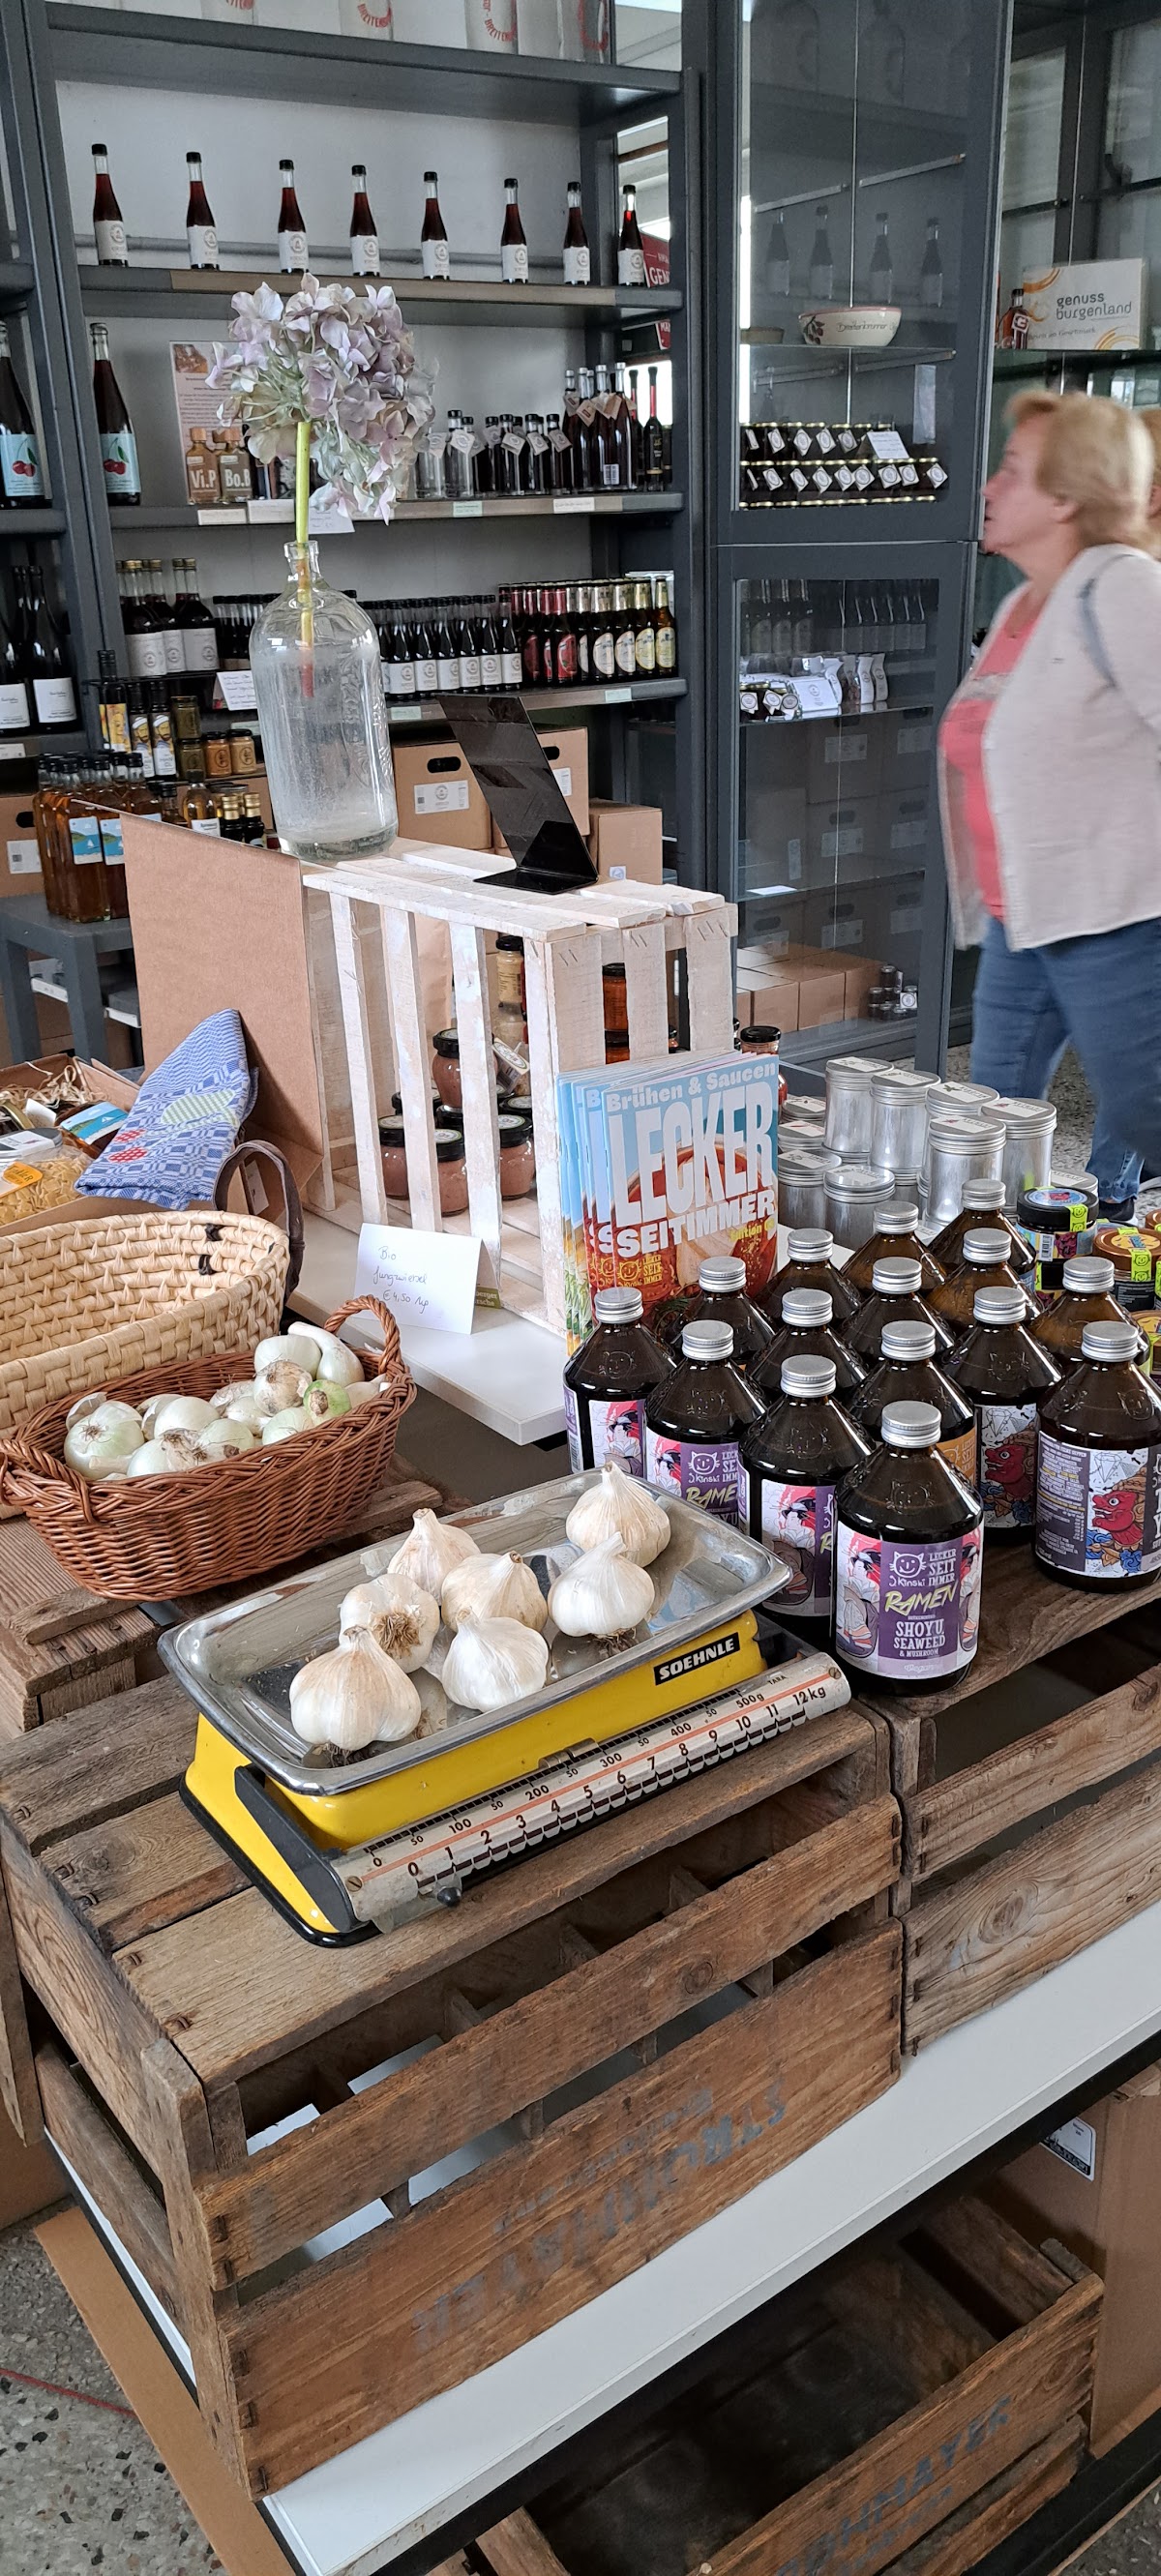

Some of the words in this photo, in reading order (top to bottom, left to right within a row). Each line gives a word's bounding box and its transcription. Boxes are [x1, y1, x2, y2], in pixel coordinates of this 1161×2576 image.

[1057, 292, 1104, 309] genuss
[1056, 302, 1132, 321] burgenland
[606, 1082, 683, 1112] Brühen
[688, 1077, 701, 1095] &
[706, 1062, 776, 1091] Saucen
[608, 1081, 774, 1228] LECKER
[378, 1246, 397, 1260] Bio
[685, 1483, 738, 1509] RAME
[929, 1548, 957, 1562] LECKER
[929, 1557, 957, 1576] SEIT
[928, 1573, 955, 1586] IMMER
[884, 1580, 959, 1616] RAMEN
[893, 1635, 945, 1650] SEAWEED
[659, 1638, 735, 1681] SOEHNLE
[906, 1648, 939, 1657] MUSHROOM
[767, 1674, 787, 1686] TARA
[372, 1856, 382, 1868] 0
[410, 1834, 424, 1847] 50
[449, 1818, 472, 1835] 100
[491, 1799, 504, 1812] 50
[524, 1784, 550, 1801] 200
[565, 1766, 579, 1779] 50
[600, 1753, 622, 1769] 300
[638, 1736, 650, 1748] 50
[670, 1722, 692, 1737] 400
[705, 1707, 717, 1718] 50
[407, 1861, 419, 1877] 0
[444, 1846, 454, 1860] 1
[480, 1829, 492, 1845] 2
[516, 1814, 526, 1829] 3
[551, 1799, 561, 1815] 4
[582, 1785, 593, 1799] 5
[616, 1770, 627, 1785] 6
[646, 1756, 656, 1771] 7
[678, 1742, 689, 1757] 8
[708, 1730, 718, 1743] 9
[735, 1715, 752, 1732] 10
[765, 1703, 780, 1718] 11
